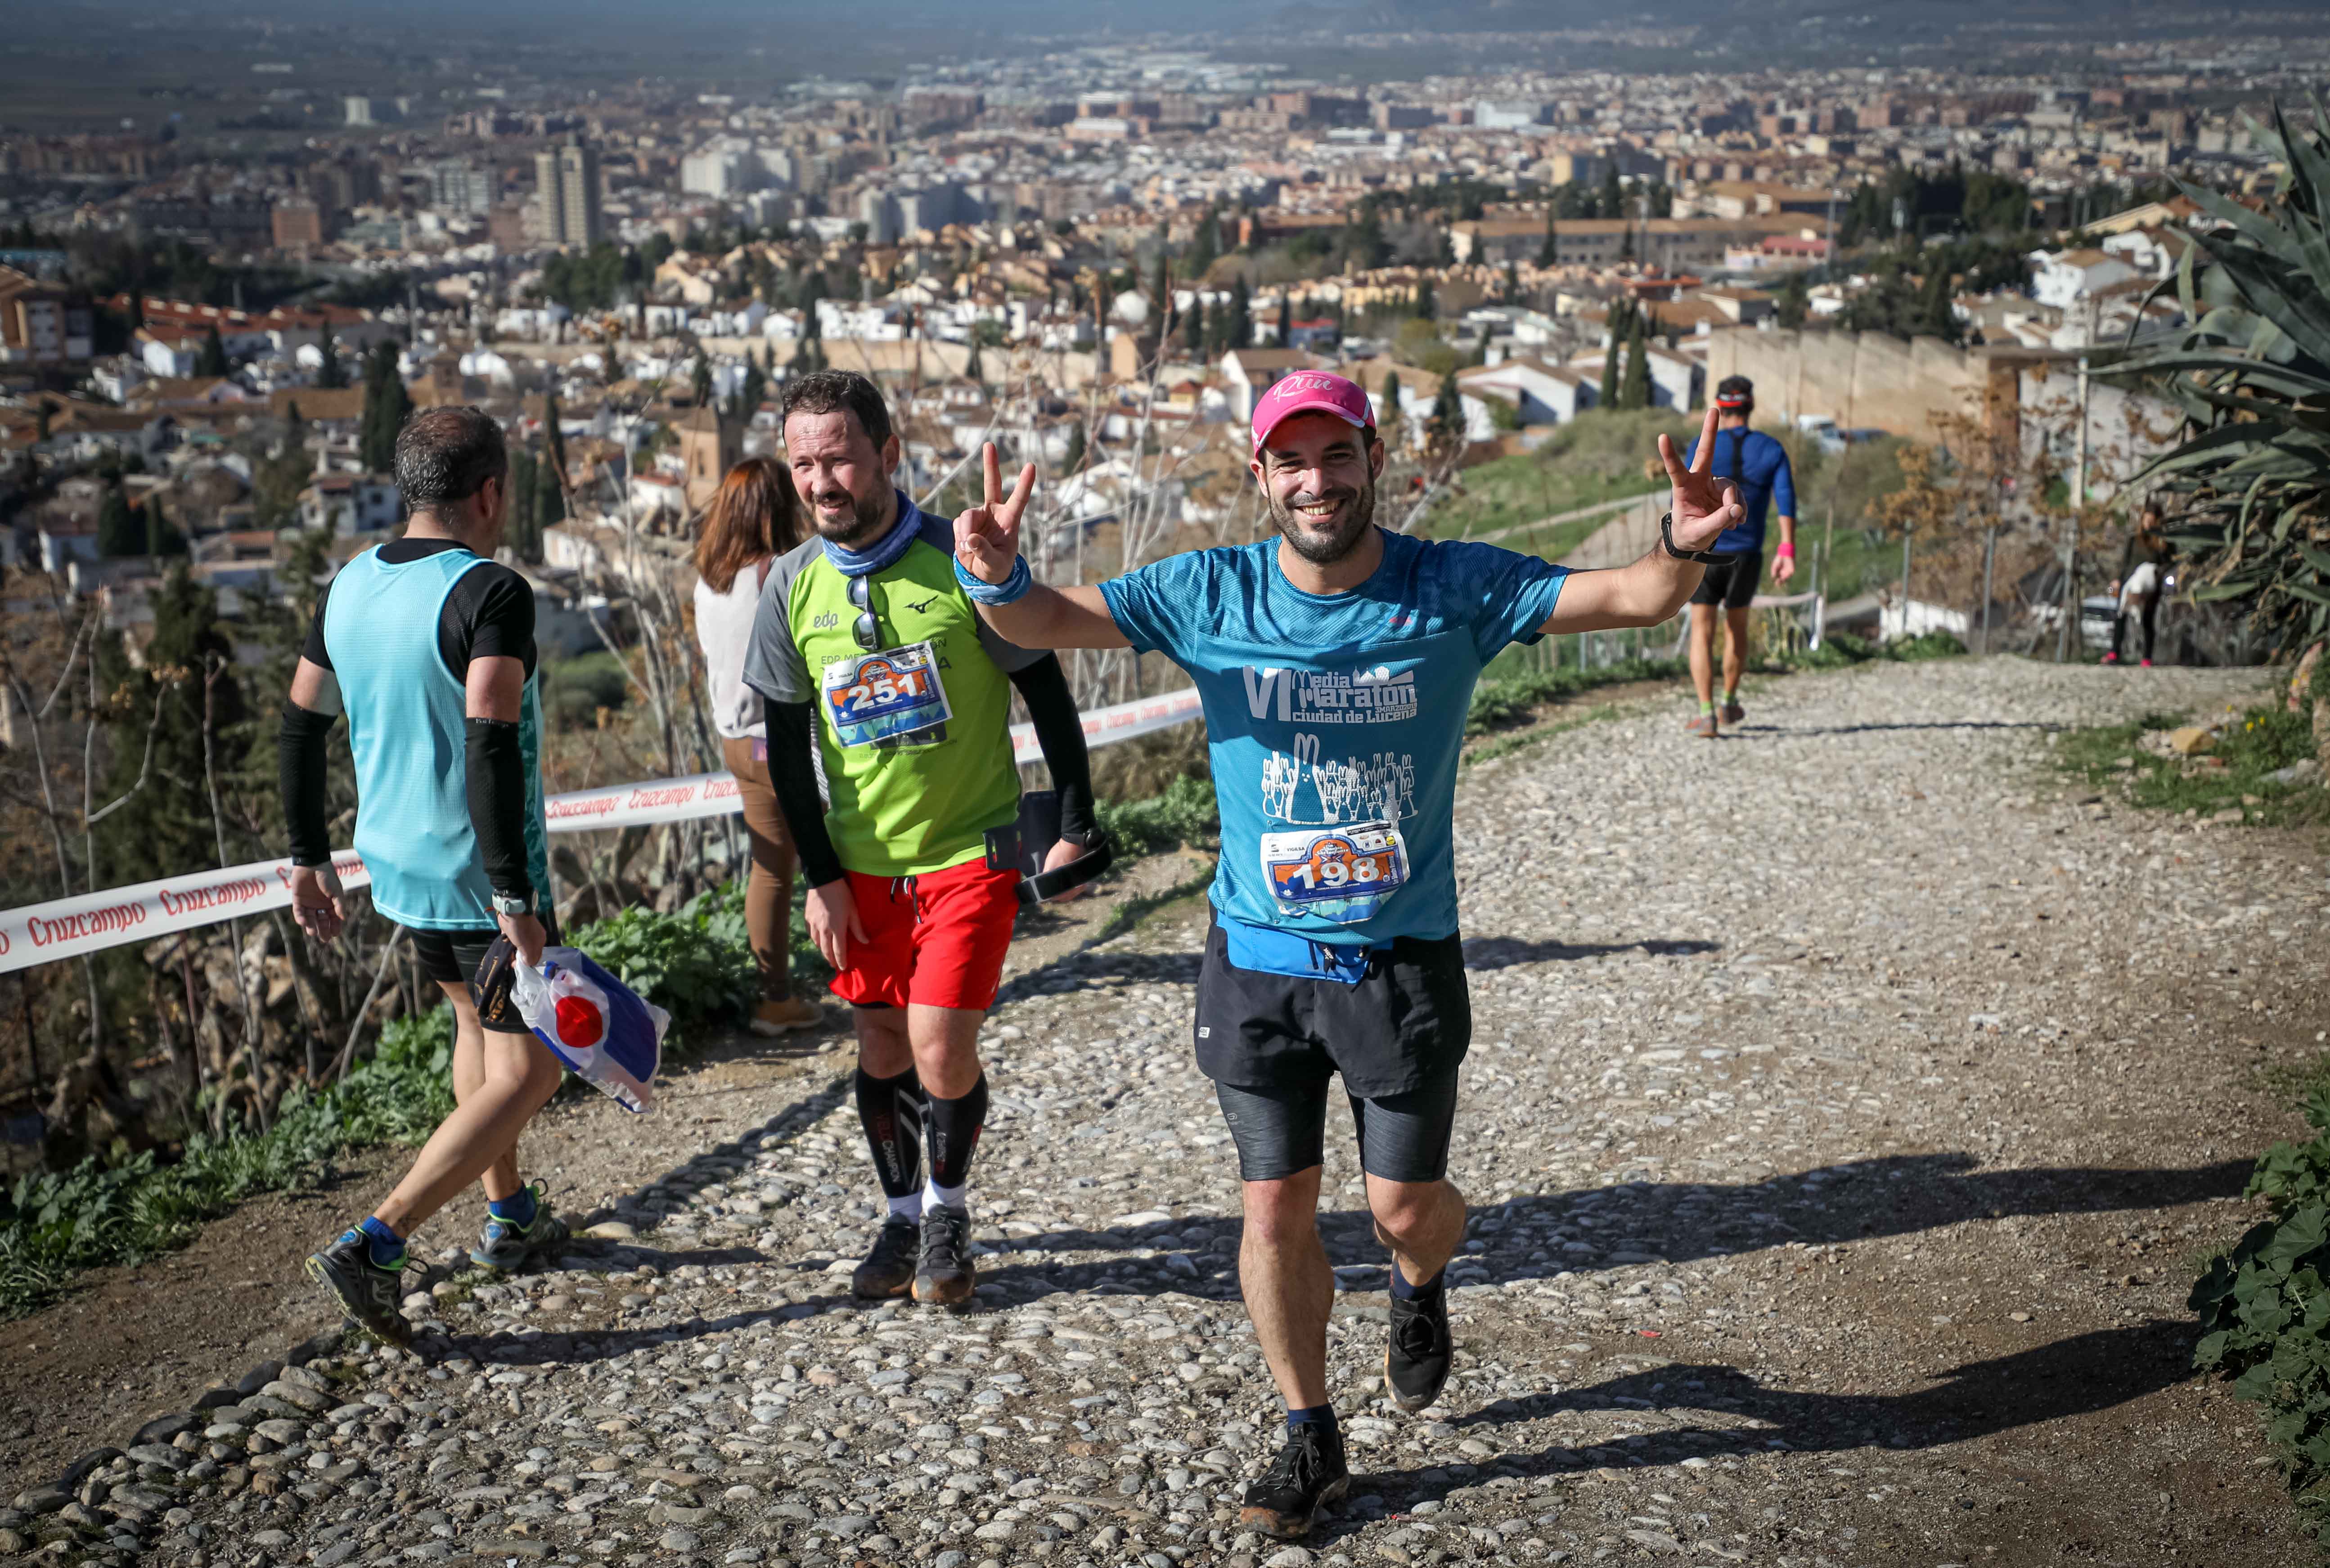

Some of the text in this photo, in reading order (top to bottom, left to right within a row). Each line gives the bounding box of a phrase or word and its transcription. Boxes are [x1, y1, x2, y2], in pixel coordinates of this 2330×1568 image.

[814, 610, 838, 630] edp
[848, 673, 918, 711] 251
[1292, 669, 1350, 689] Media
[1242, 665, 1292, 722] VI
[1293, 708, 1417, 723] ciudad de Lucena
[629, 786, 695, 809] Cruzcampo
[1293, 857, 1379, 889] 198
[27, 901, 146, 946] Cruzcampo
[159, 877, 266, 916] Cruzcampo
